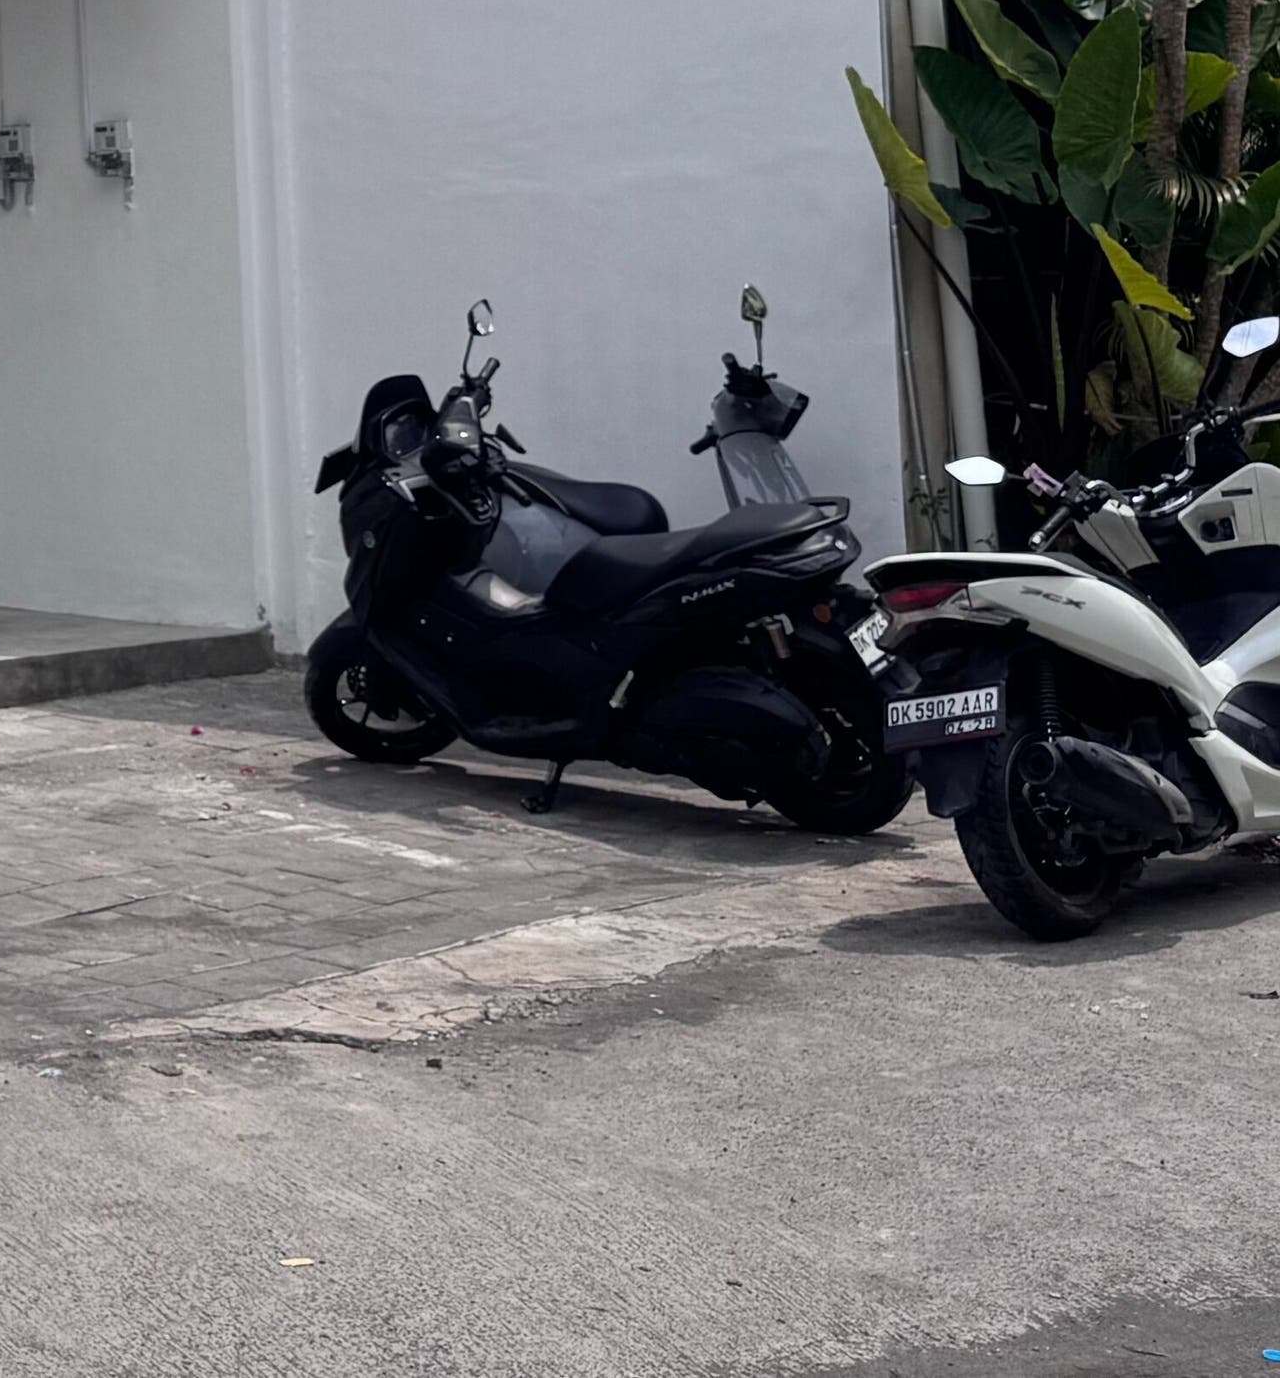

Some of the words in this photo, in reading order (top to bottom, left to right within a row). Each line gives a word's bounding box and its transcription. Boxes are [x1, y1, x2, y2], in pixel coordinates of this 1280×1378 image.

[890, 704, 911, 724] DK
[915, 697, 956, 720] 5902
[961, 692, 994, 714] AAR
